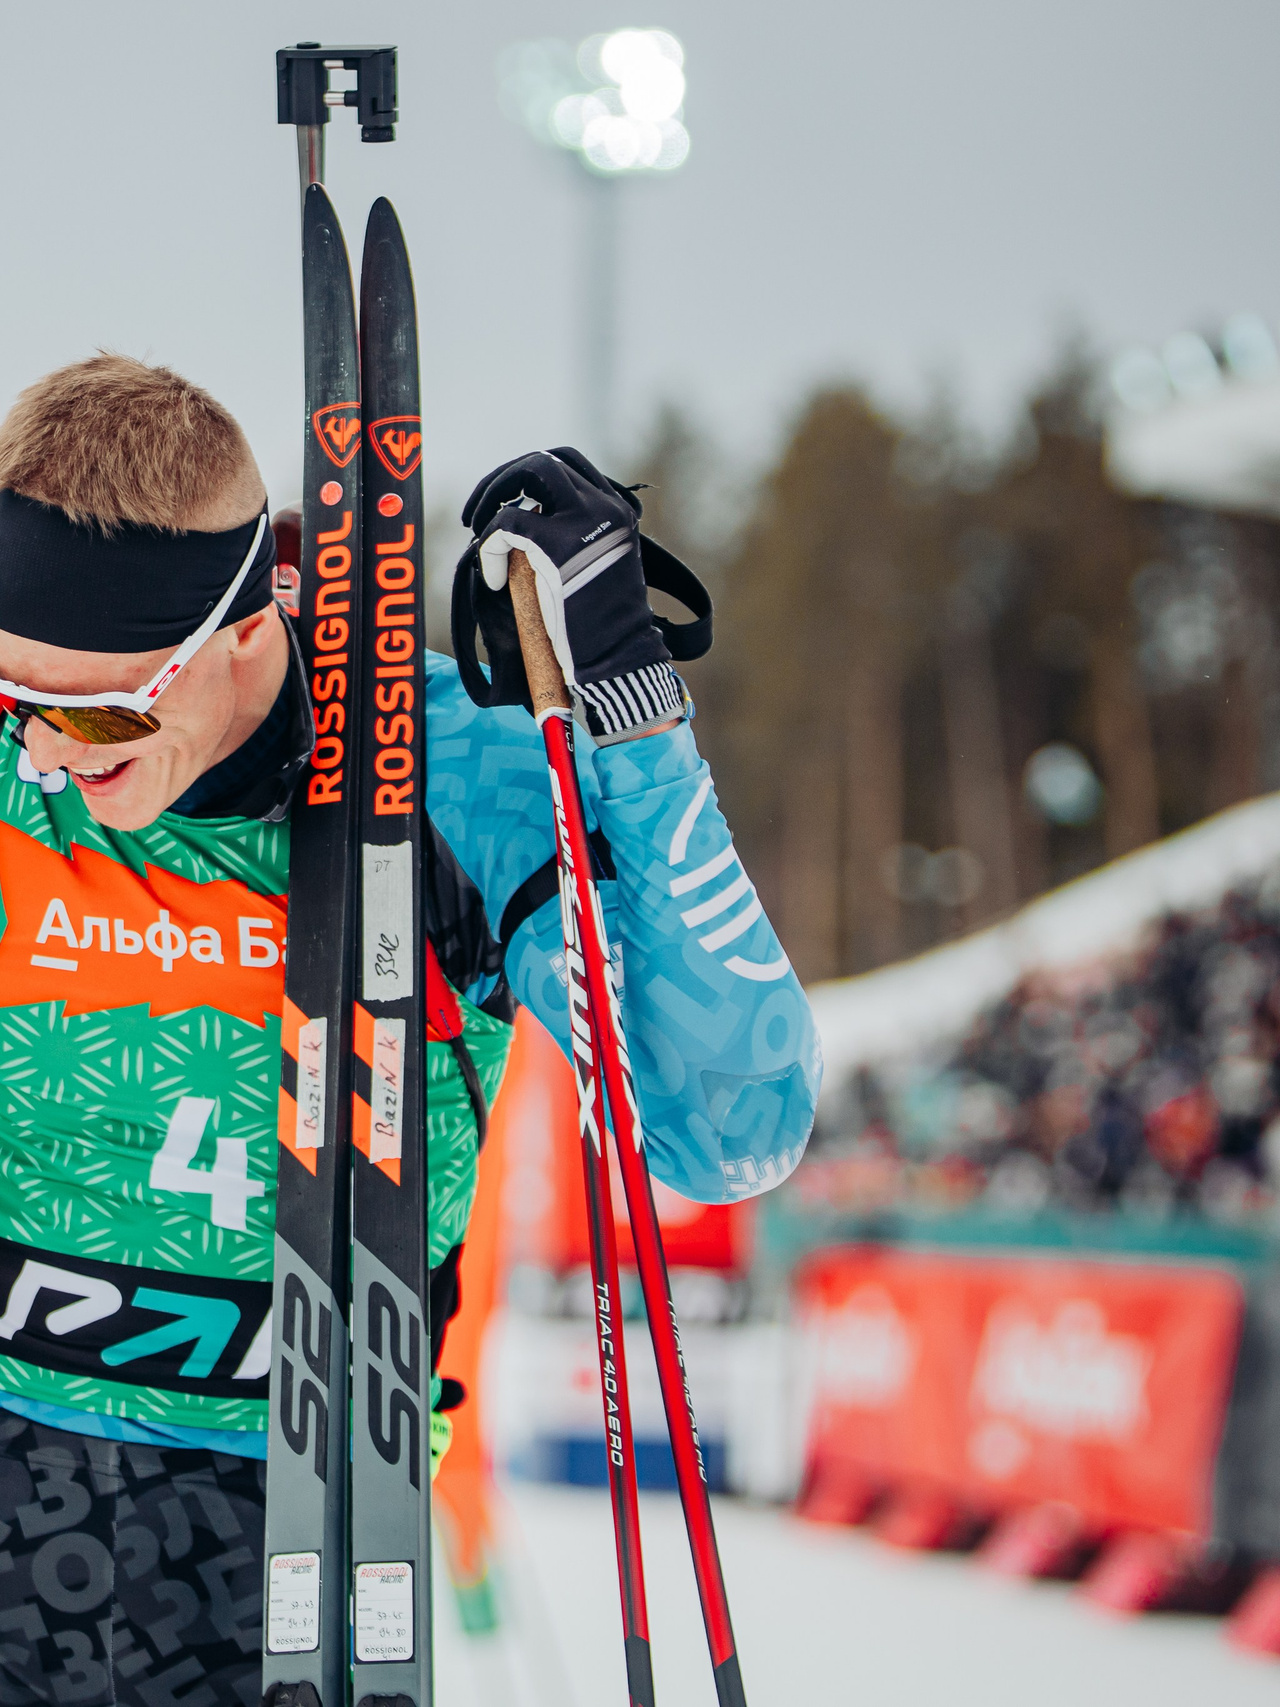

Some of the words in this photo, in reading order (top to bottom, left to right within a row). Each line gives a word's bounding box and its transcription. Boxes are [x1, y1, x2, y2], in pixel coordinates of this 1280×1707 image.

[581, 526, 603, 543] Legend
[307, 511, 353, 806] ROSSIGNOL
[374, 524, 415, 815] ROSSIGNOL
[35, 898, 224, 973] Альфа
[149, 1097, 265, 1231] 4
[596, 1282, 614, 1356] TRIAC
[606, 1395, 624, 1467] AERO
[273, 1557, 317, 1570] ROSSIGNOL
[360, 1566, 409, 1578] ROSSIGNOL
[275, 1636, 314, 1645] ROSSIGNOL
[364, 1646, 409, 1655] ROSSIGNOL
